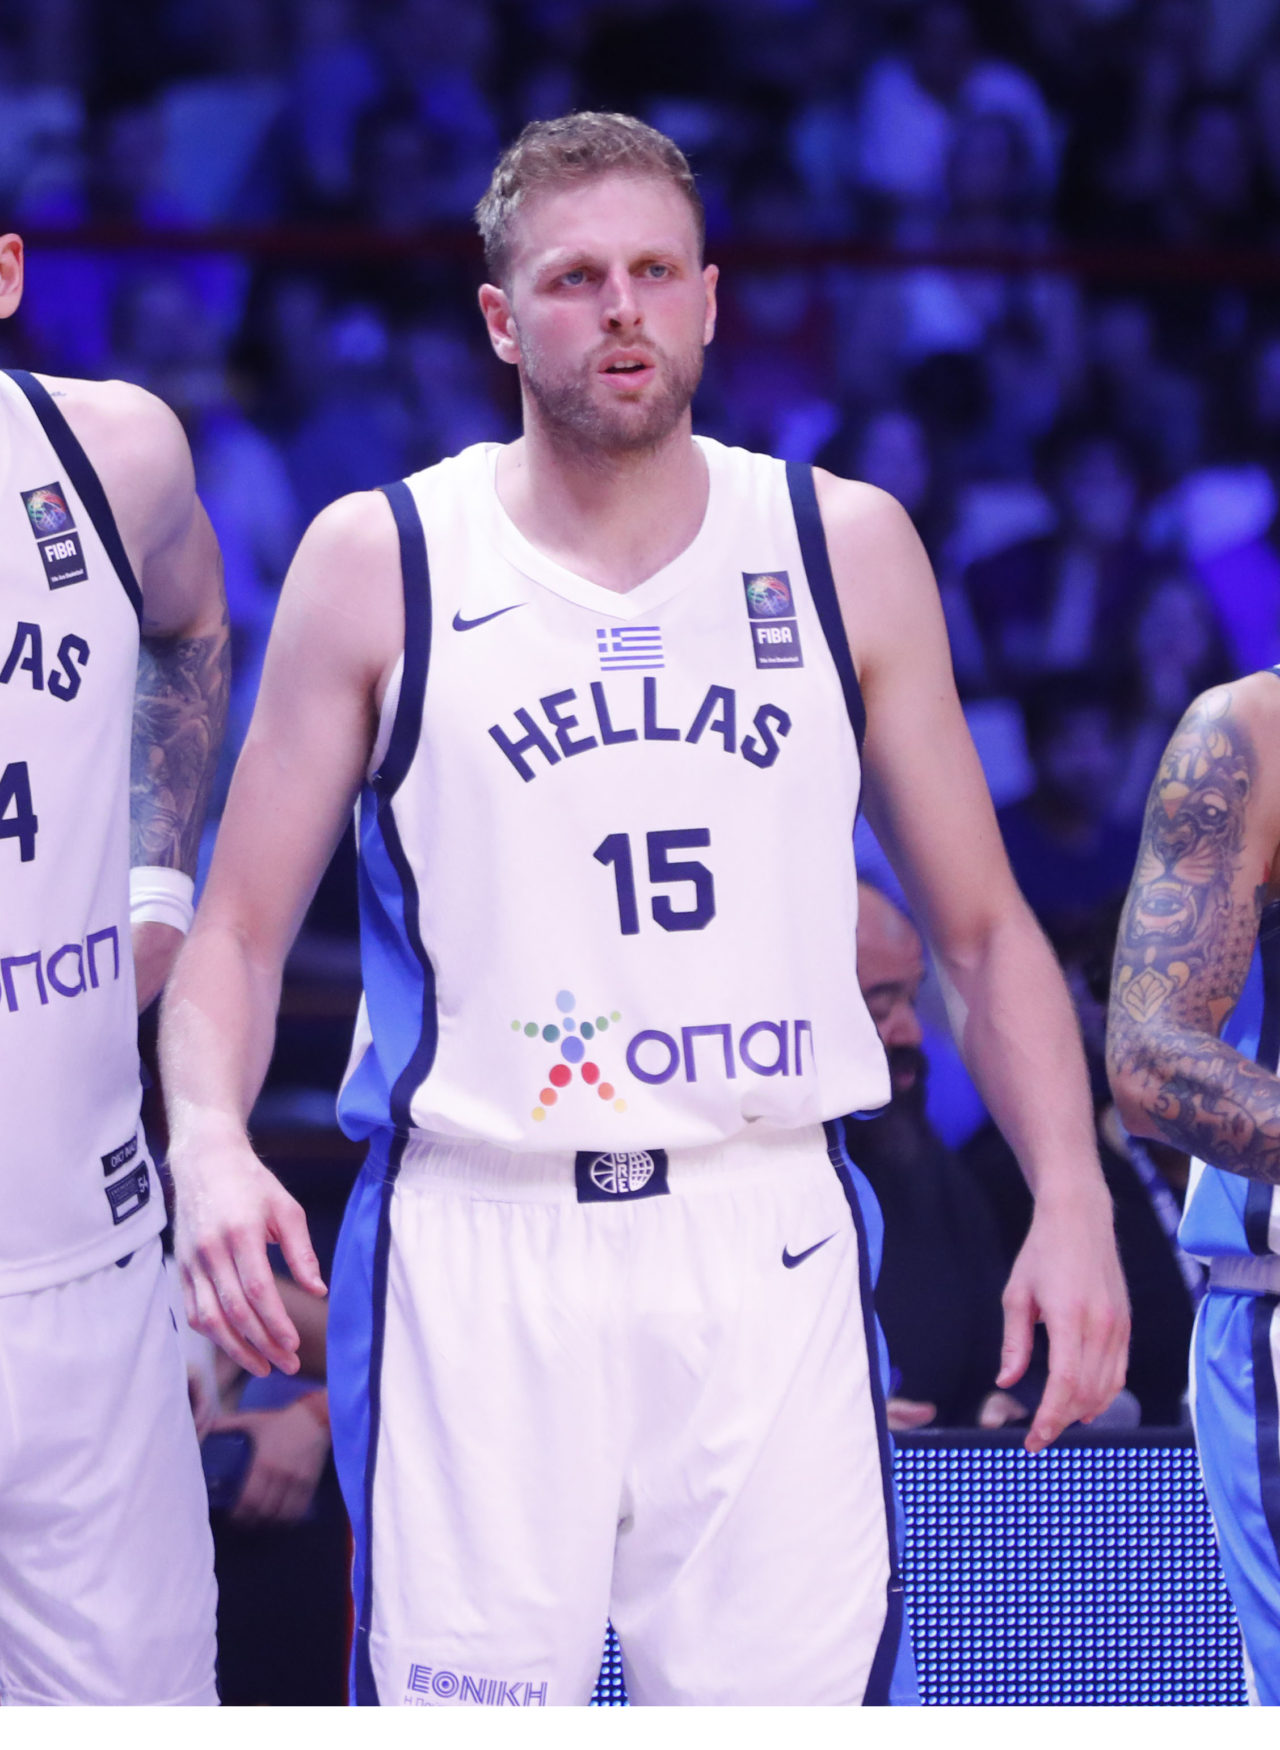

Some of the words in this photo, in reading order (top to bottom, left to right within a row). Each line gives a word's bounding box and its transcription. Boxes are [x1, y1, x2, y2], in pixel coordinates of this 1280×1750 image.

[44, 539, 77, 563] FIBA
[756, 626, 793, 644] FIBA
[488, 676, 792, 783] HELLAS
[593, 828, 716, 935] 15
